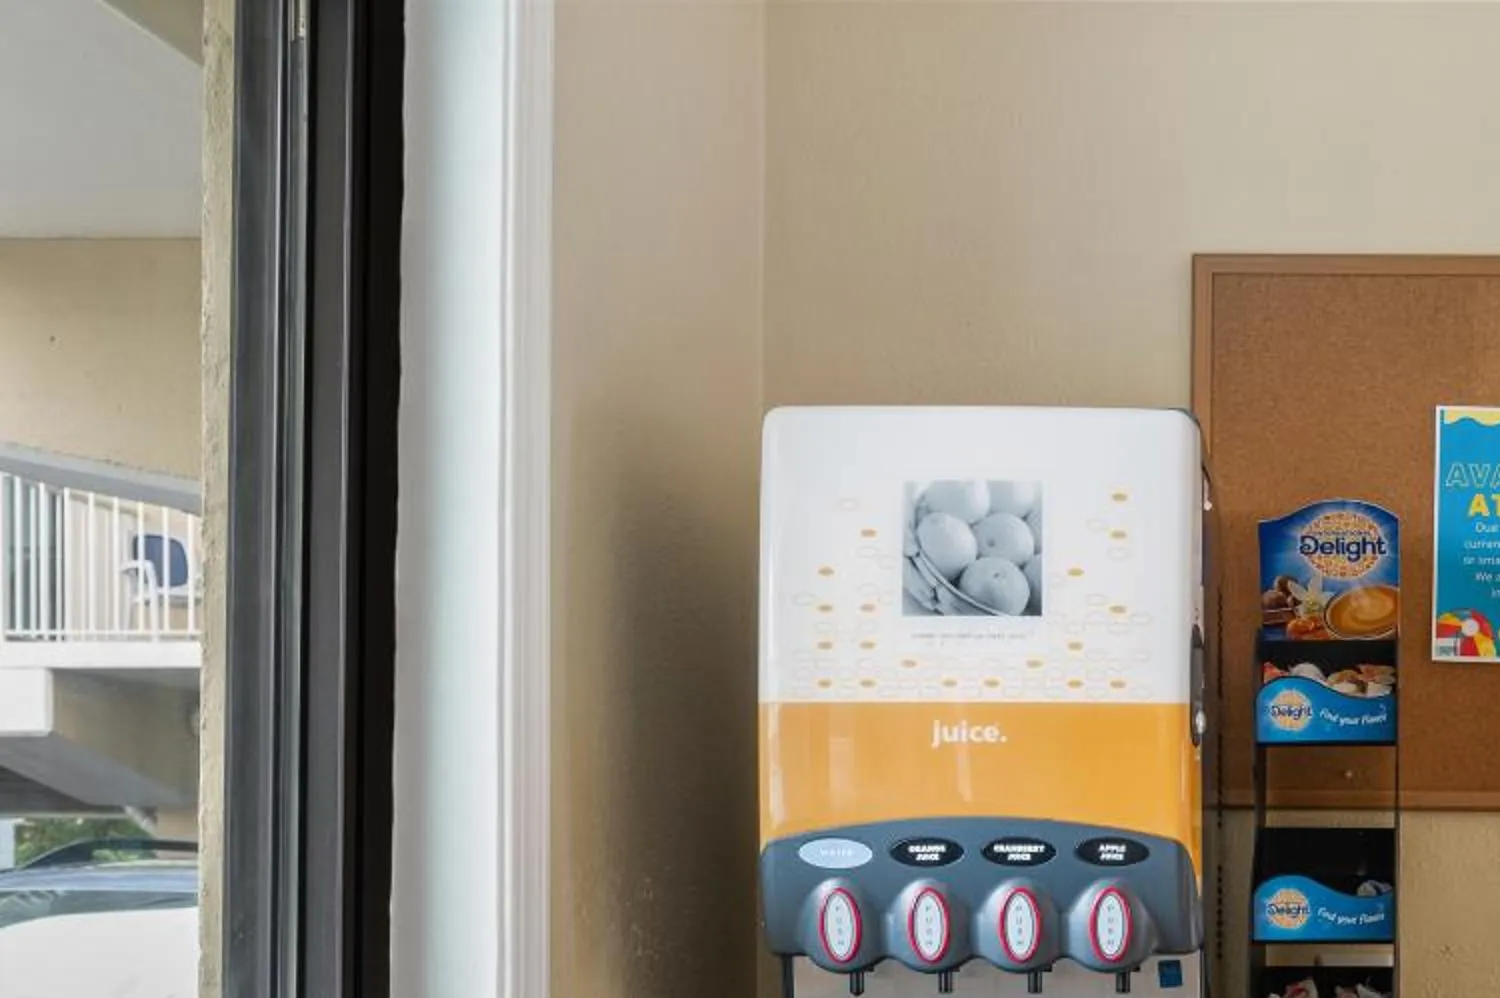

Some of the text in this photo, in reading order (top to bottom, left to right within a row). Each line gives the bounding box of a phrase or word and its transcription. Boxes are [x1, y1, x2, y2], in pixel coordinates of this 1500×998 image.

[1475, 521, 1498, 533] Due
[1300, 535, 1387, 562] Delight
[1463, 557, 1474, 565] or
[1475, 572, 1493, 580] We
[932, 719, 1007, 748] juice.
[908, 845, 946, 853] ORANGE
[993, 844, 1045, 853] CRANBERRY
[1098, 844, 1126, 853] APPLE
